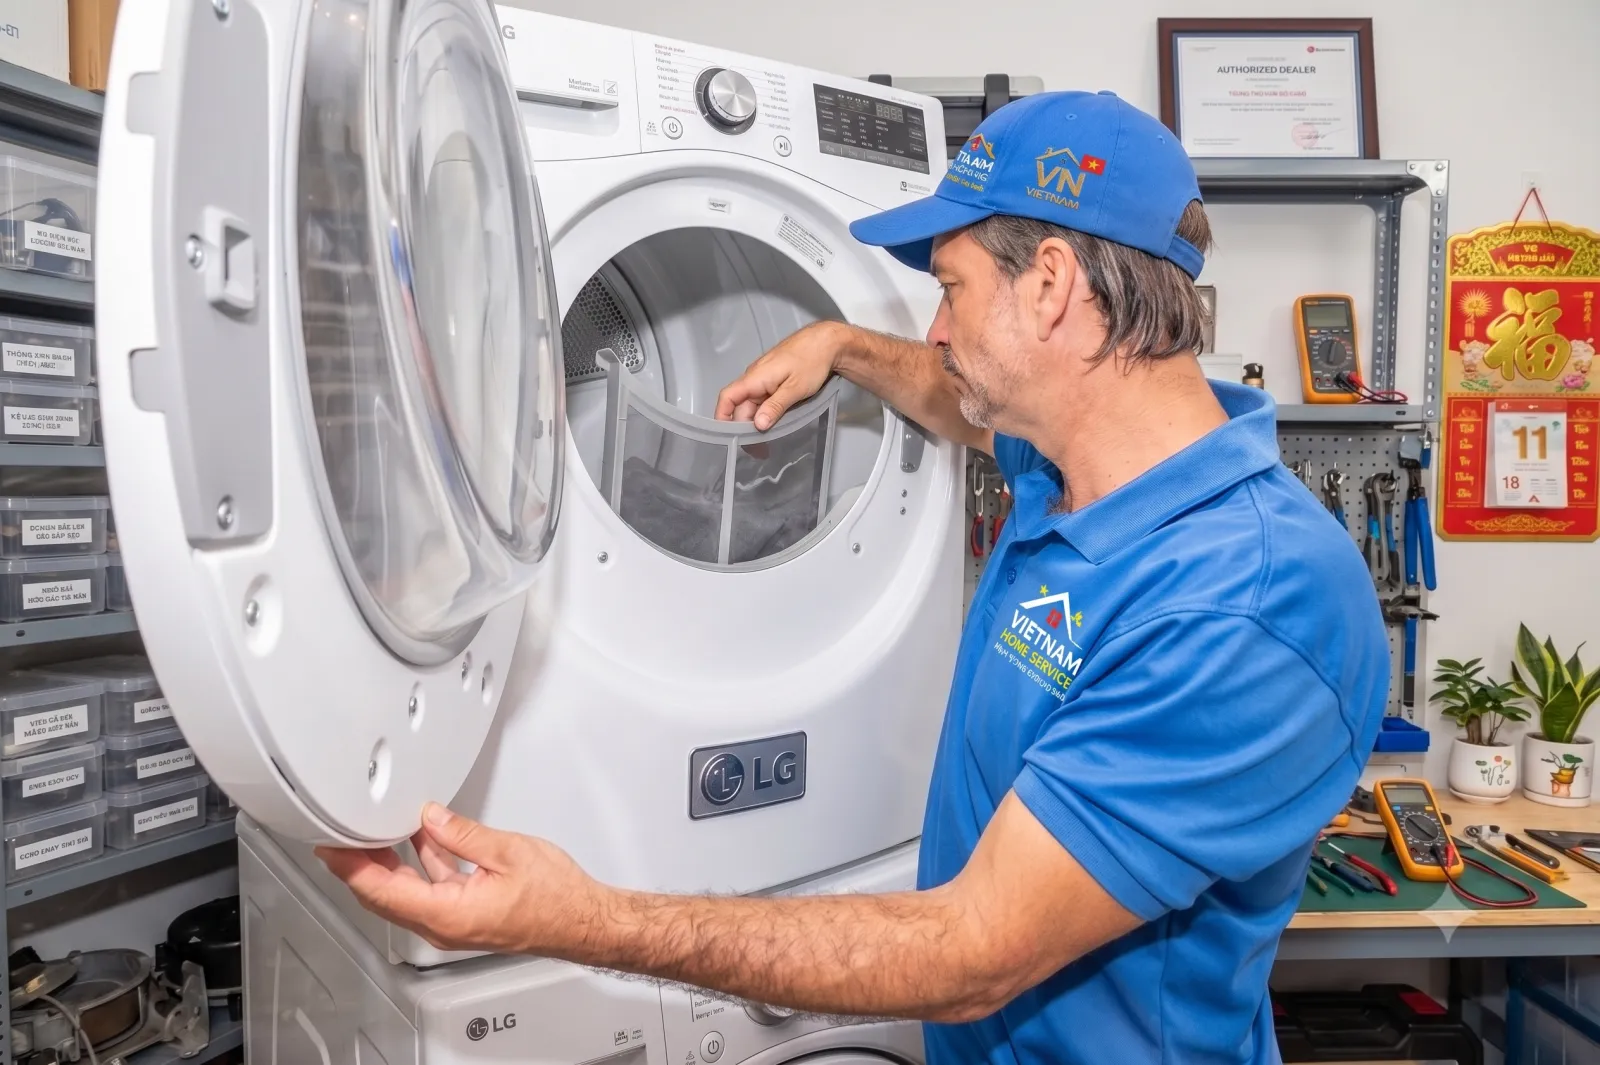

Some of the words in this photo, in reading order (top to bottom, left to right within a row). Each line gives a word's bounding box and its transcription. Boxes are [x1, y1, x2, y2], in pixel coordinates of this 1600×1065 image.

[1217, 66, 1278, 75] AUTHORIZED
[1279, 66, 1316, 75] DEALER
[1036, 159, 1086, 198] VN
[1025, 186, 1079, 210] VIETNAM
[1512, 425, 1548, 460] 11
[1502, 475, 1520, 490] 18
[1000, 627, 1030, 658] HOME
[1028, 651, 1073, 690] SERVICE
[1011, 608, 1083, 676] VIETNAM
[752, 751, 797, 791] LG
[493, 1013, 516, 1033] LG
